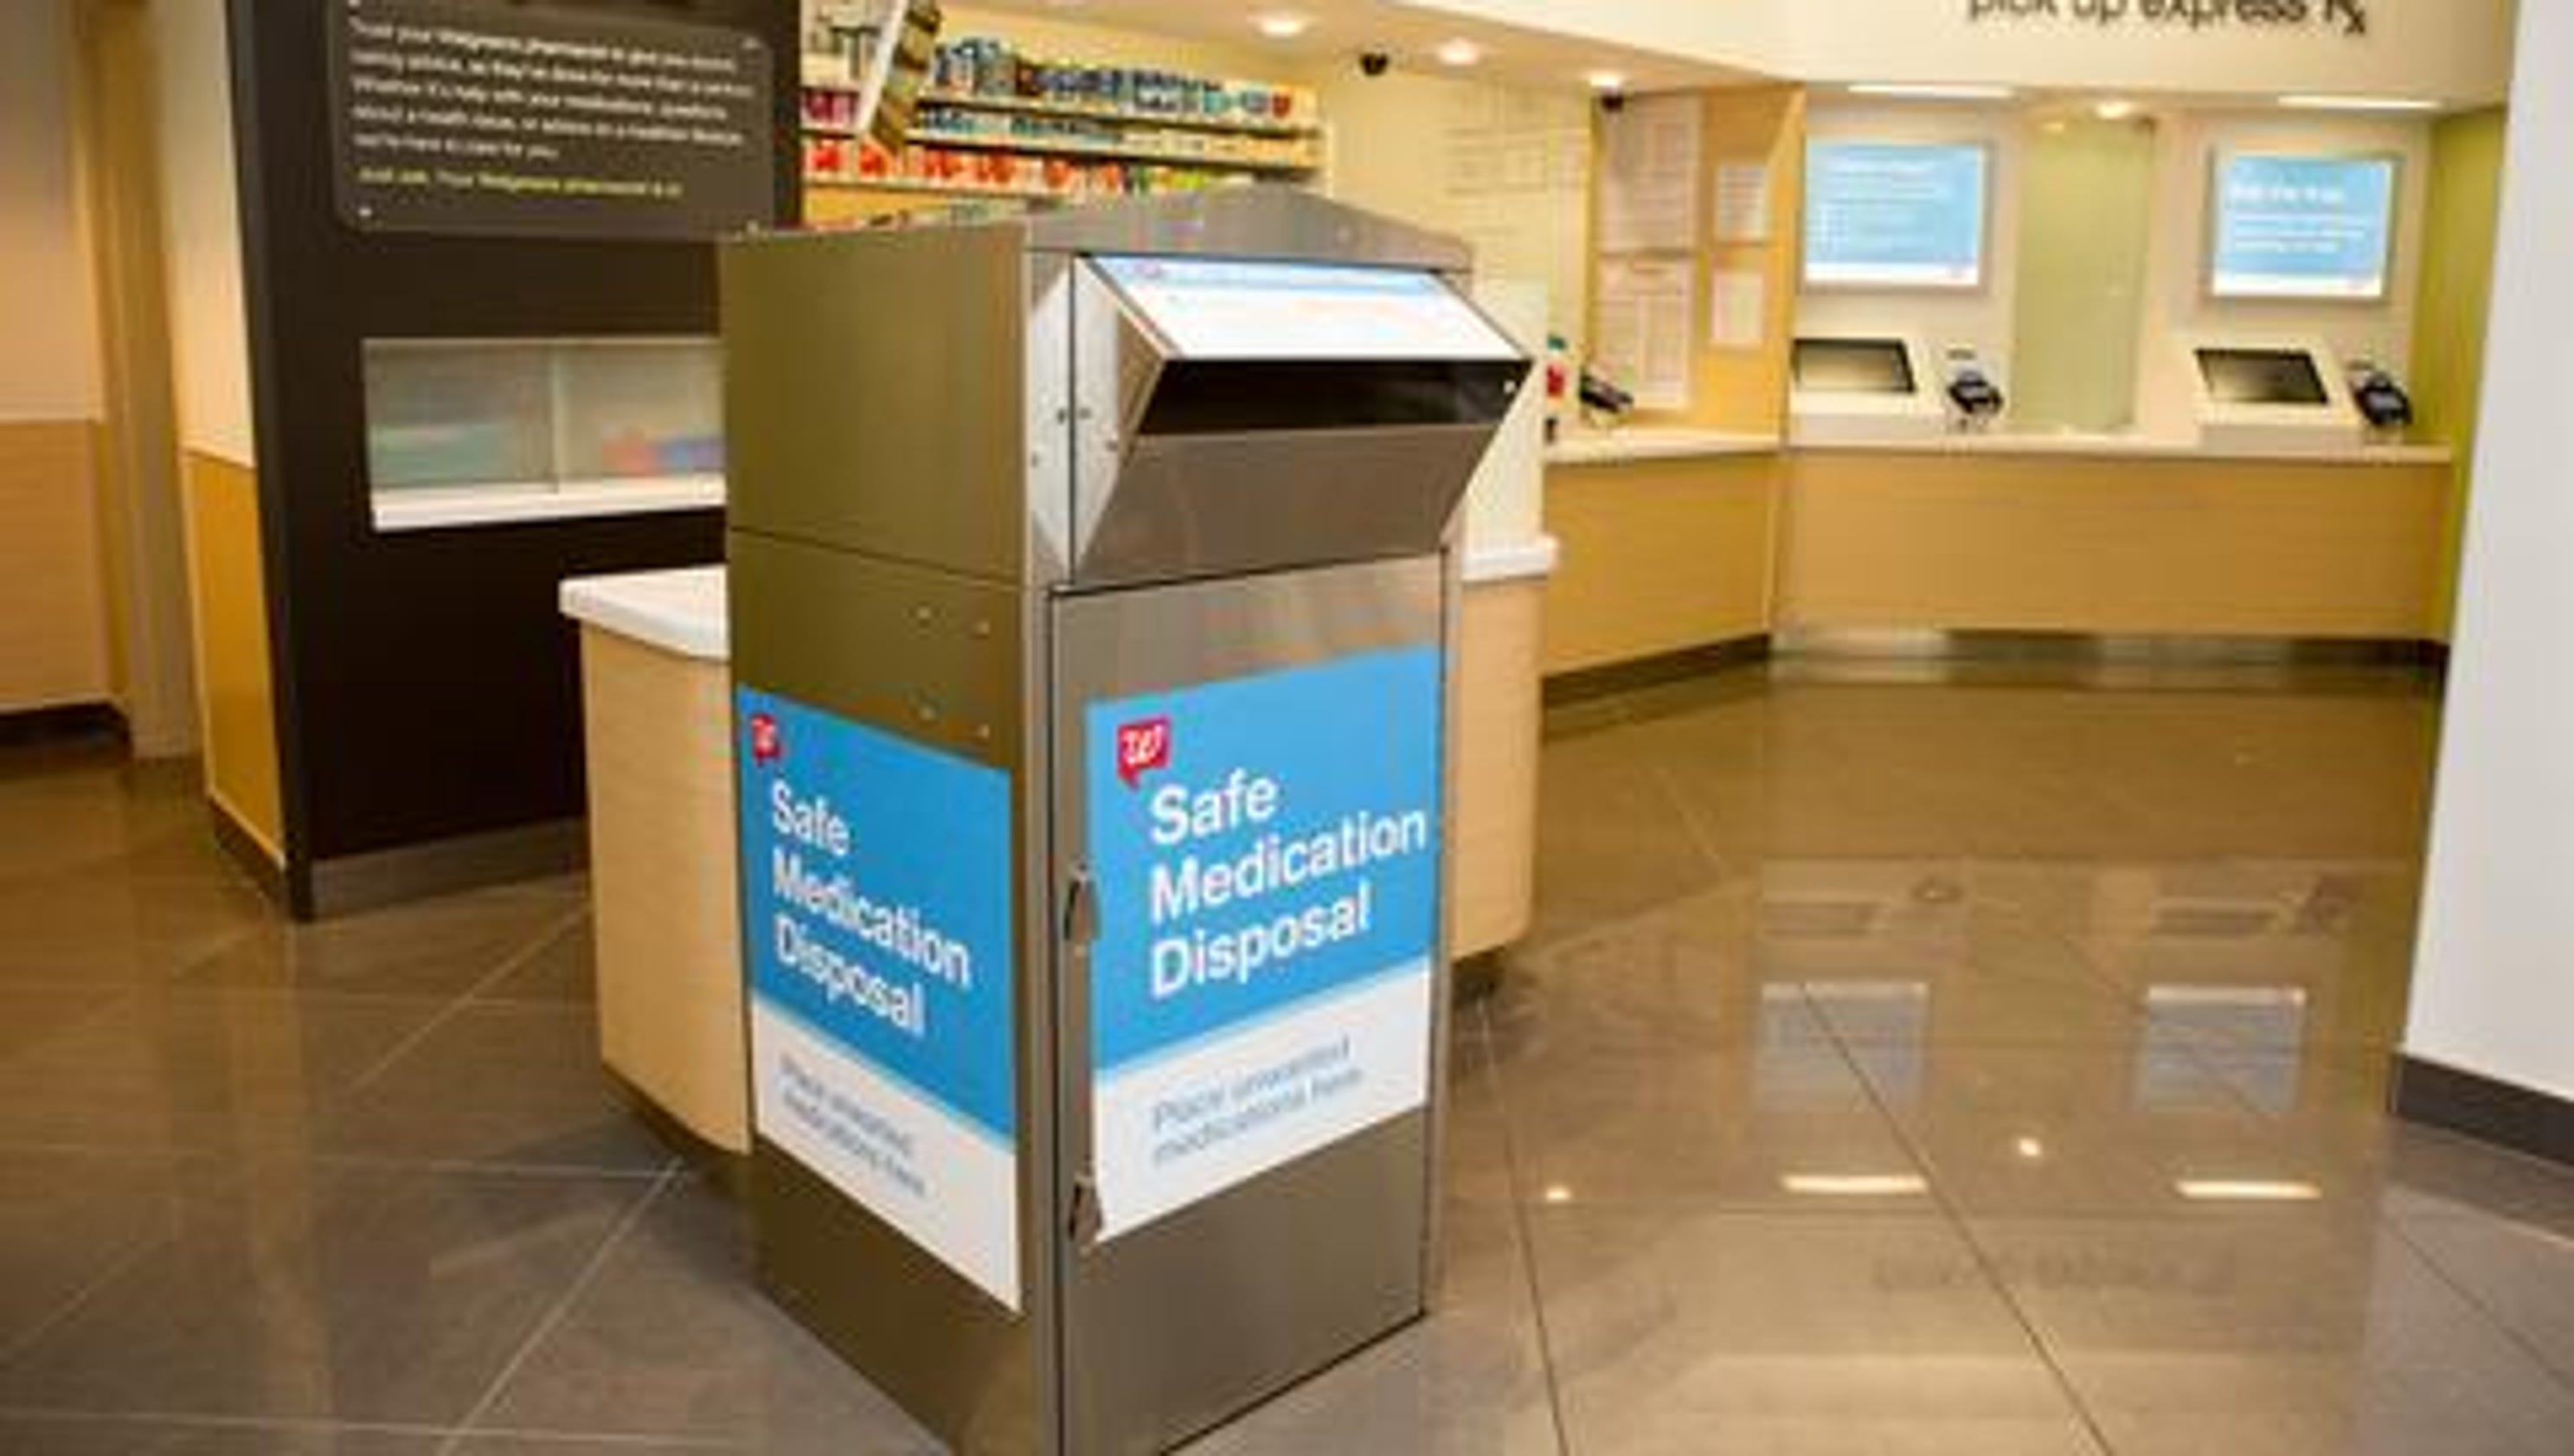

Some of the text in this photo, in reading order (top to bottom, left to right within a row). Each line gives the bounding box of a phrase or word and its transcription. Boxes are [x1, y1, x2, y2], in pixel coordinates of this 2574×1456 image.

[2076, 0, 2128, 25] up
[2139, 0, 2308, 29] express
[772, 779, 850, 858] Safe
[1151, 768, 1277, 846] Safe
[773, 846, 972, 991] Medication
[1151, 807, 1427, 927] Medication
[775, 915, 926, 1037] Disposal
[1151, 882, 1371, 1001] Disposal
